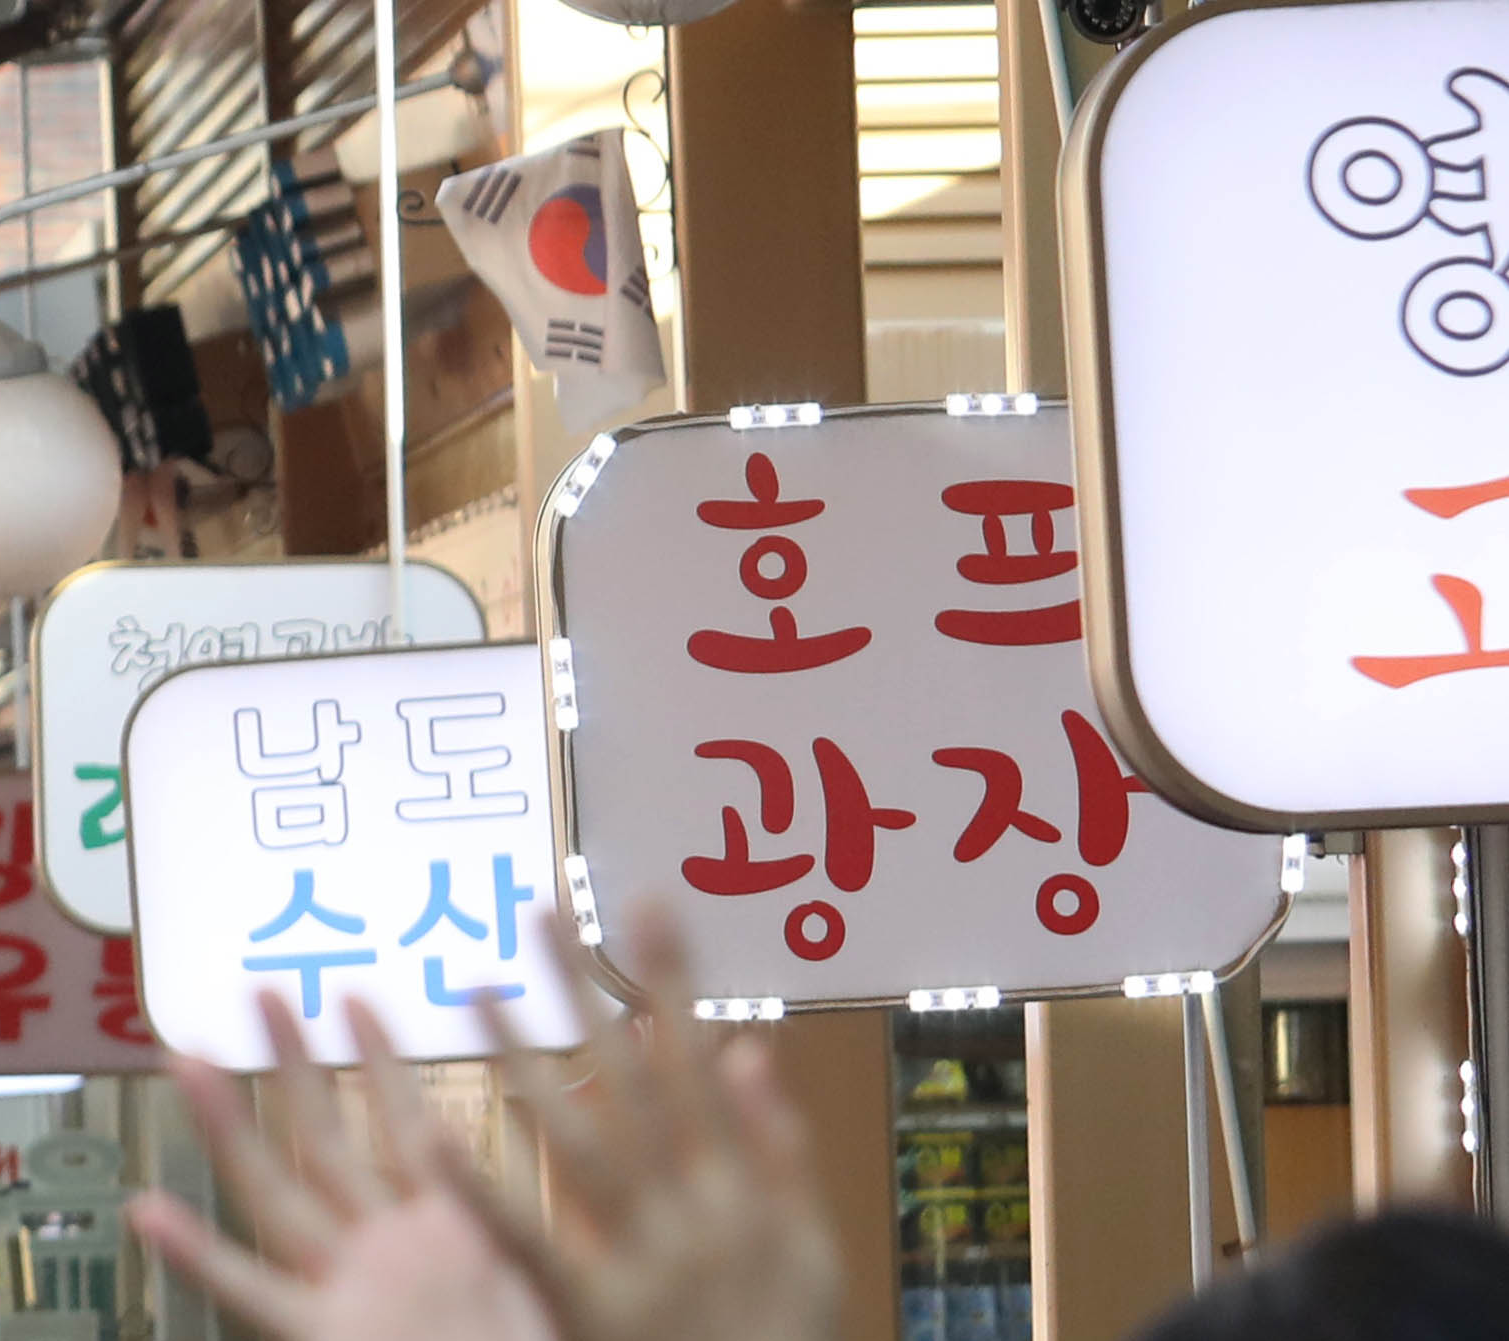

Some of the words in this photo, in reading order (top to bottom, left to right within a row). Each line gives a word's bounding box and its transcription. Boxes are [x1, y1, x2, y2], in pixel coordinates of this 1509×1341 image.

[687, 452, 1082, 674] 호프
[233, 692, 529, 850] 남도
[681, 709, 1149, 962] 광장
[241, 852, 534, 1020] 수산
